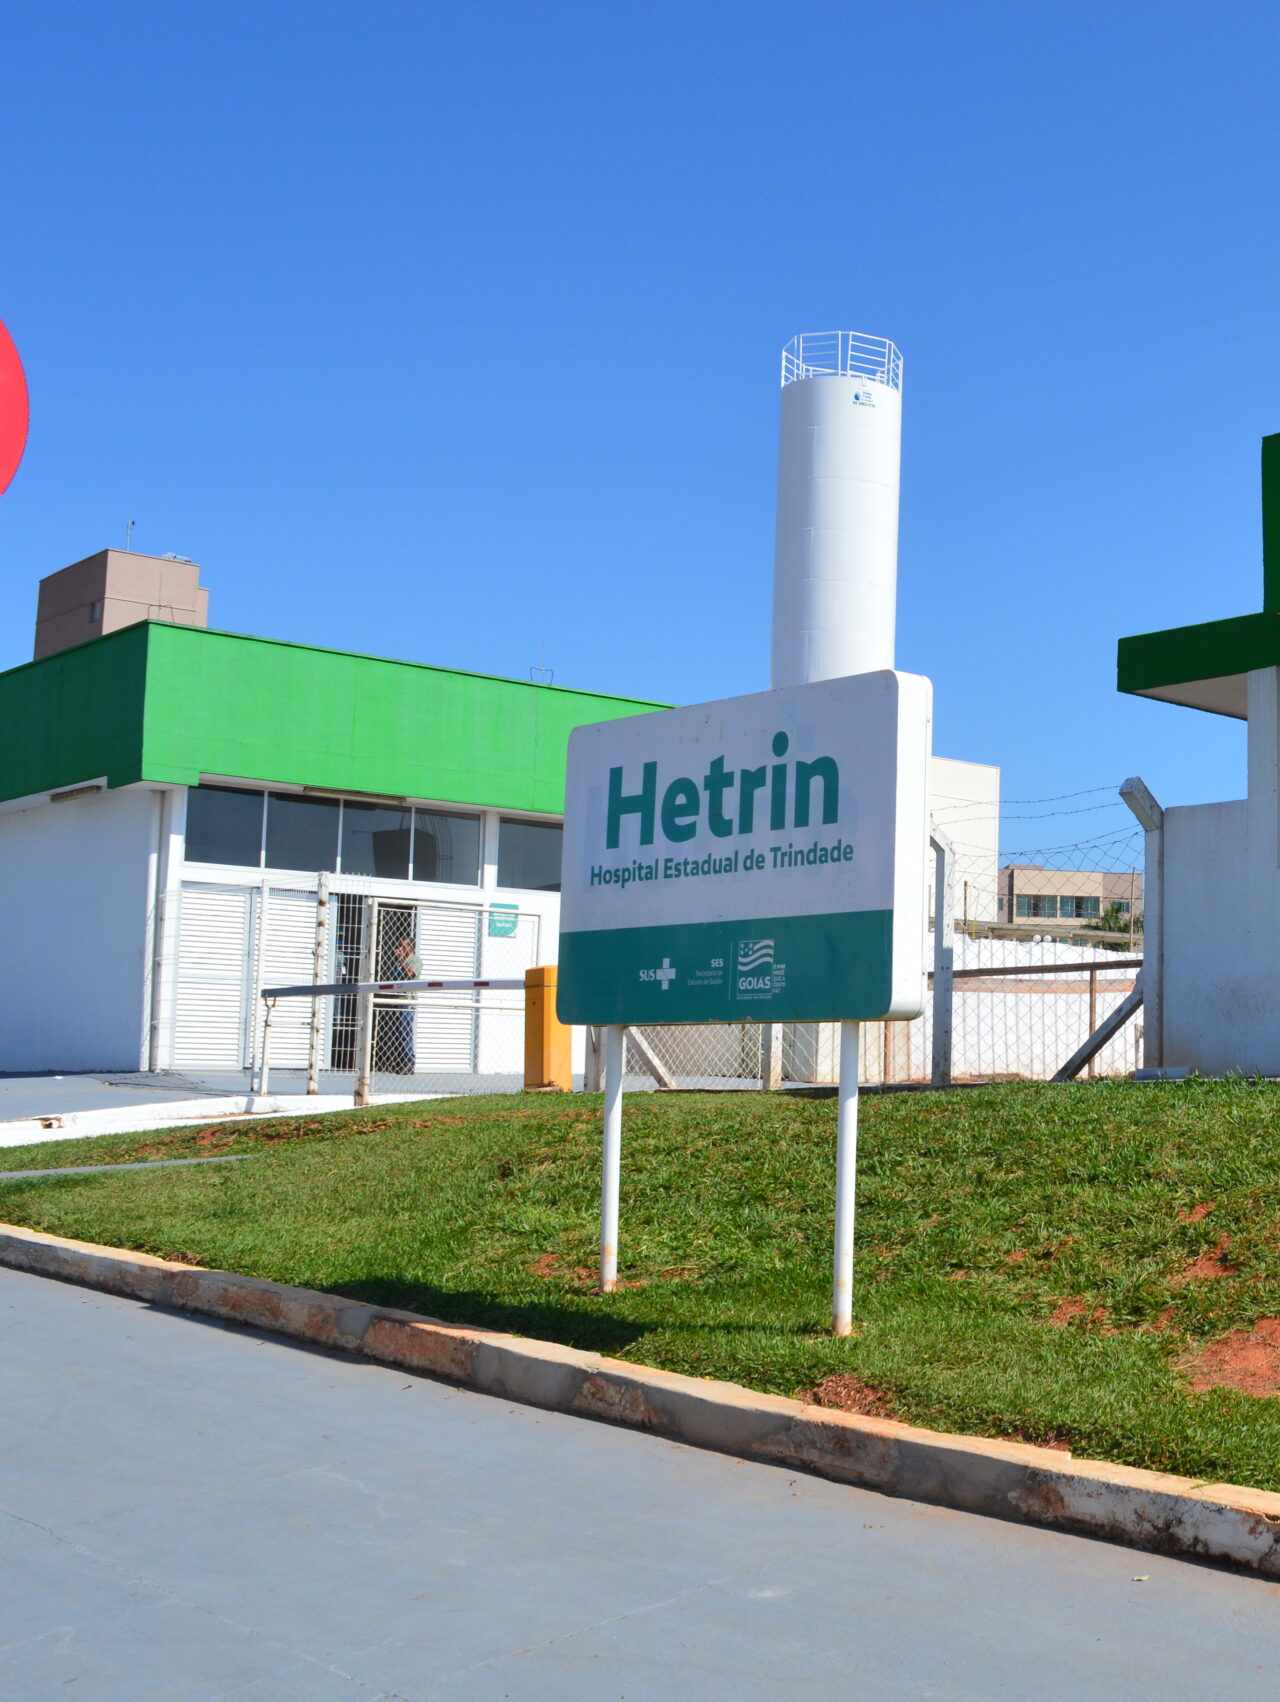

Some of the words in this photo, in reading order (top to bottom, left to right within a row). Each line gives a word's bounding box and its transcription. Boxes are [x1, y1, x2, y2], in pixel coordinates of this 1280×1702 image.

[606, 731, 839, 849] Hetrin
[590, 858, 659, 889] Hospital
[663, 849, 738, 880] Estadual
[743, 848, 765, 872] de
[769, 838, 854, 869] Trindade
[639, 969, 655, 982] SUS
[711, 958, 724, 968] SES
